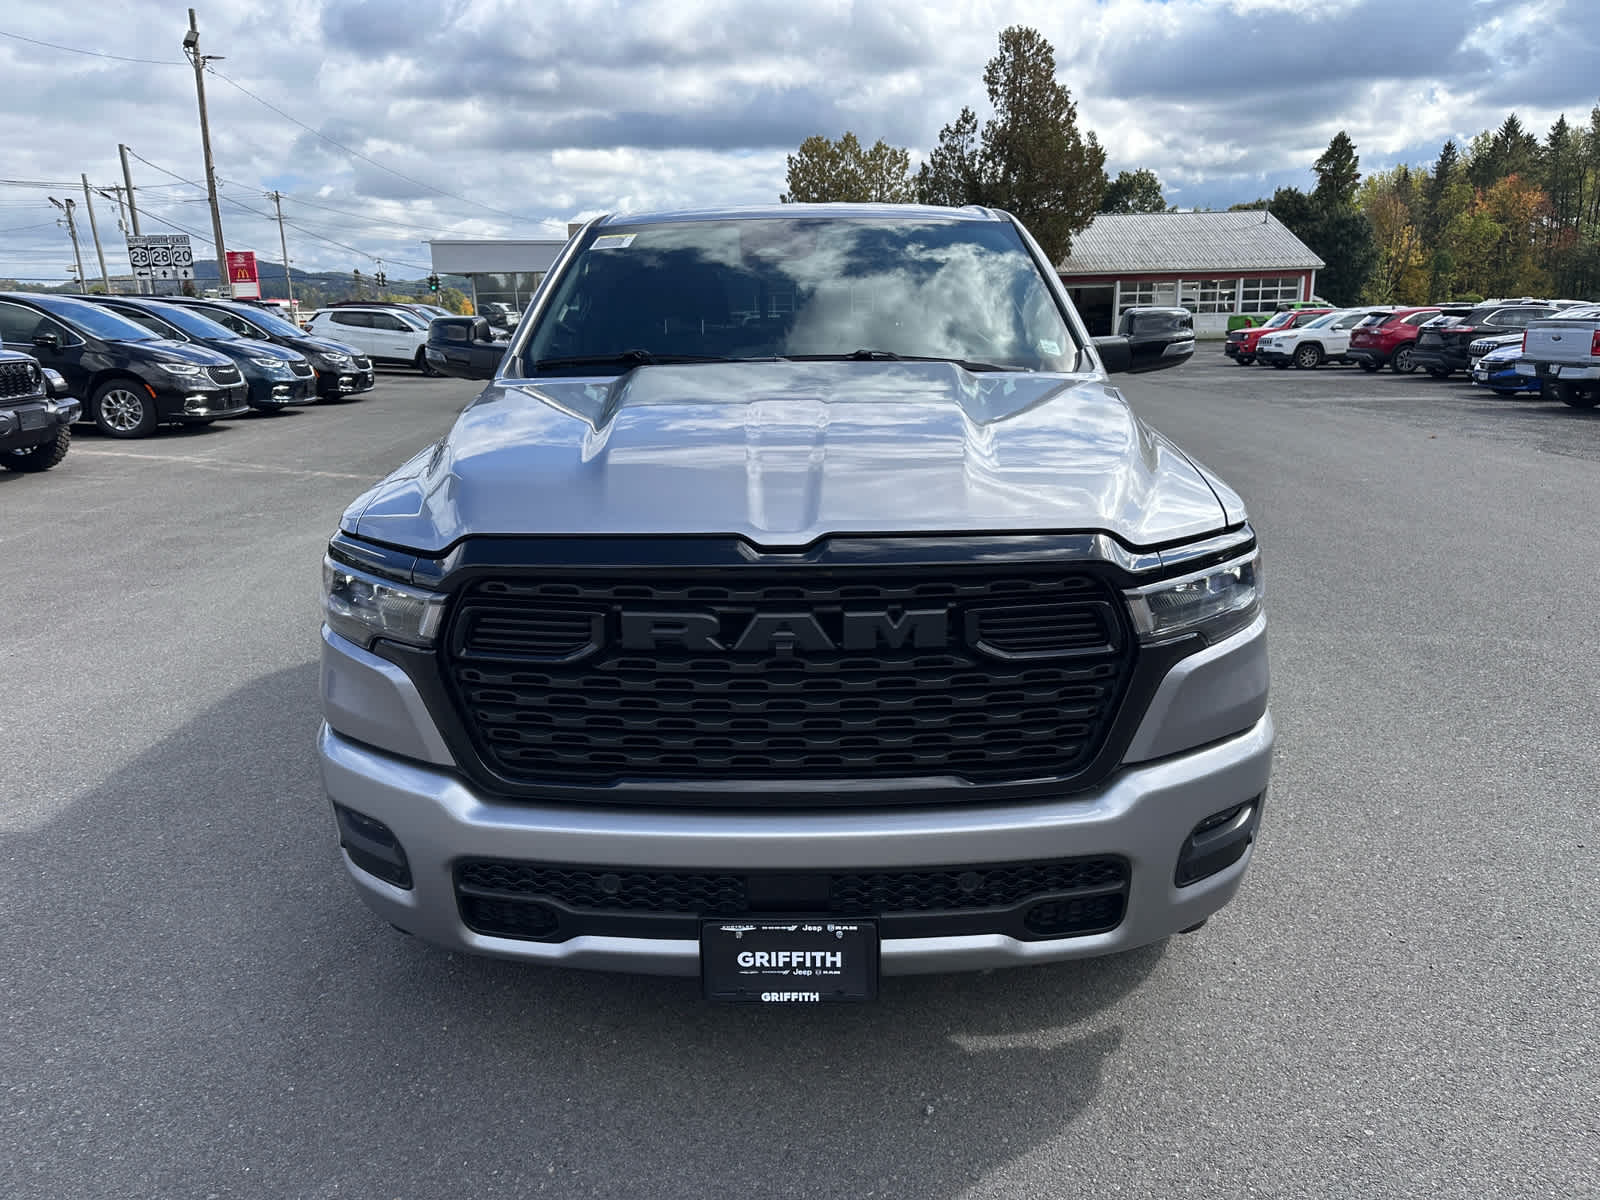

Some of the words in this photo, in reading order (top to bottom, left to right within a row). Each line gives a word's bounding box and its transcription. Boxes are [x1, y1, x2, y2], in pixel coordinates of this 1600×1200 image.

[172, 236, 188, 244] EAST
[131, 251, 148, 262] 28
[153, 251, 169, 262] 28
[174, 251, 190, 262] 20
[621, 610, 948, 650] RAM
[737, 951, 842, 967] GRIFFITH
[761, 992, 819, 1002] GRIFFITH
